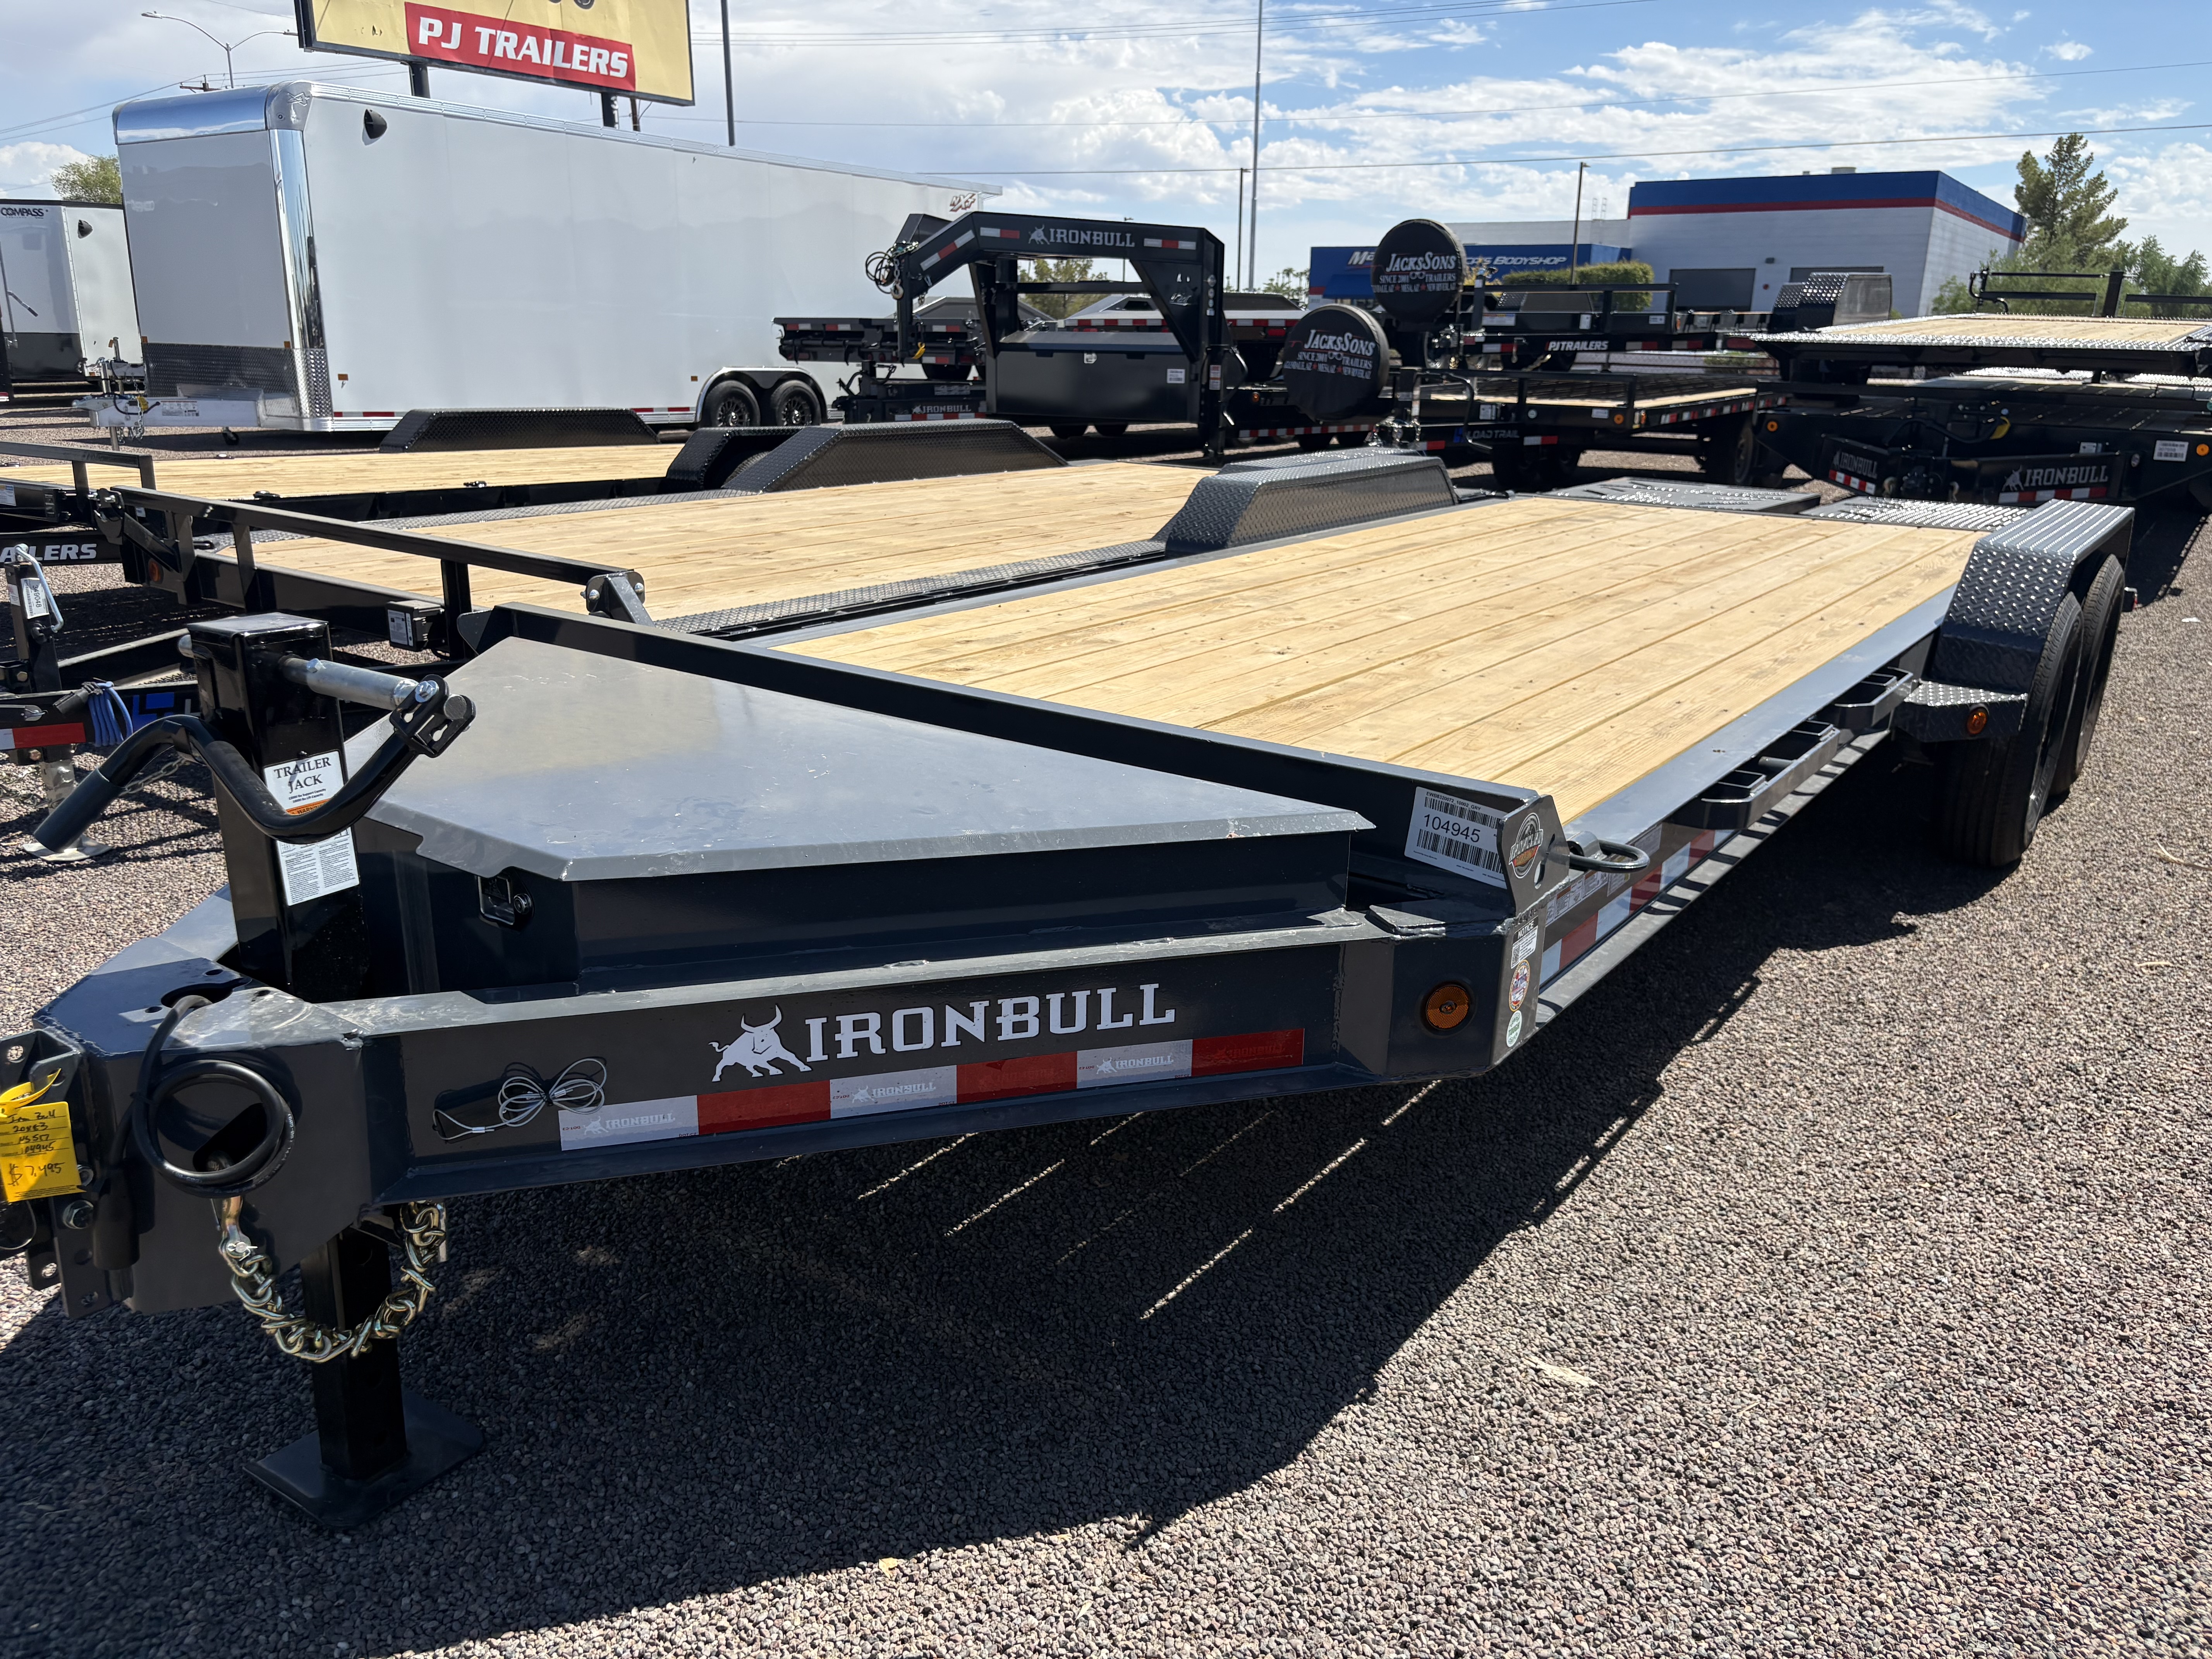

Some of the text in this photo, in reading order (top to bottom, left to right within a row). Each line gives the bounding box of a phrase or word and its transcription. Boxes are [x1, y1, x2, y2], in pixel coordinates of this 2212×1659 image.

[419, 17, 629, 78] PJ TRAILERS
[1, 207, 44, 216] COMPASS
[1049, 228, 1135, 247] IRONBULL
[1425, 273, 1456, 283] TRAILERS
[1840, 452, 1877, 479] IRONBULL
[2024, 465, 2108, 487] IRONBULL
[274, 757, 331, 778] TRAILER
[288, 774, 323, 793] JACK
[1424, 814, 1480, 842] 104945
[1518, 921, 1534, 939] NOTICE
[805, 983, 1175, 1062] IRONBULL
[1115, 1055, 1174, 1068] IRONBULL
[872, 1082, 936, 1096] IRONBULL
[605, 1113, 675, 1129] IRONBULL
